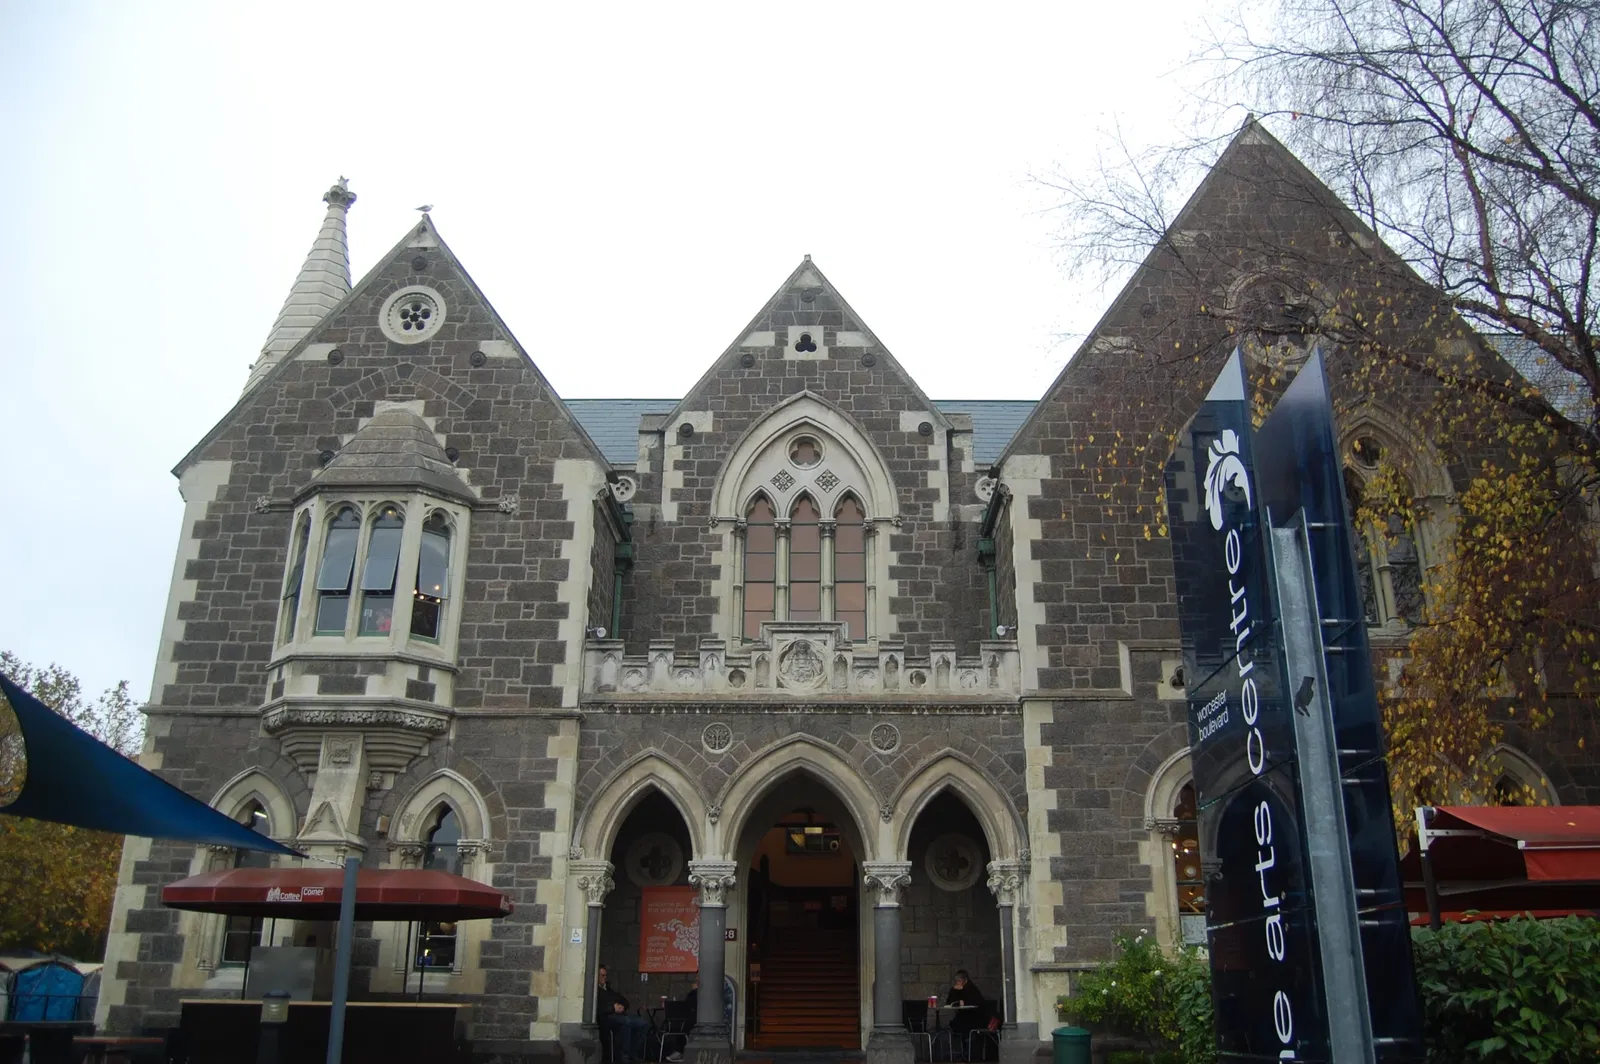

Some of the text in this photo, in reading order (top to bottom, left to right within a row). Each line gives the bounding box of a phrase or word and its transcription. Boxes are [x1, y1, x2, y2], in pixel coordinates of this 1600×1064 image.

[1225, 528, 1264, 775] centre
[1196, 689, 1227, 723] worcester
[1198, 706, 1229, 742] boulevard
[280, 888, 324, 900] Coffee Corner
[1255, 800, 1285, 961] arts
